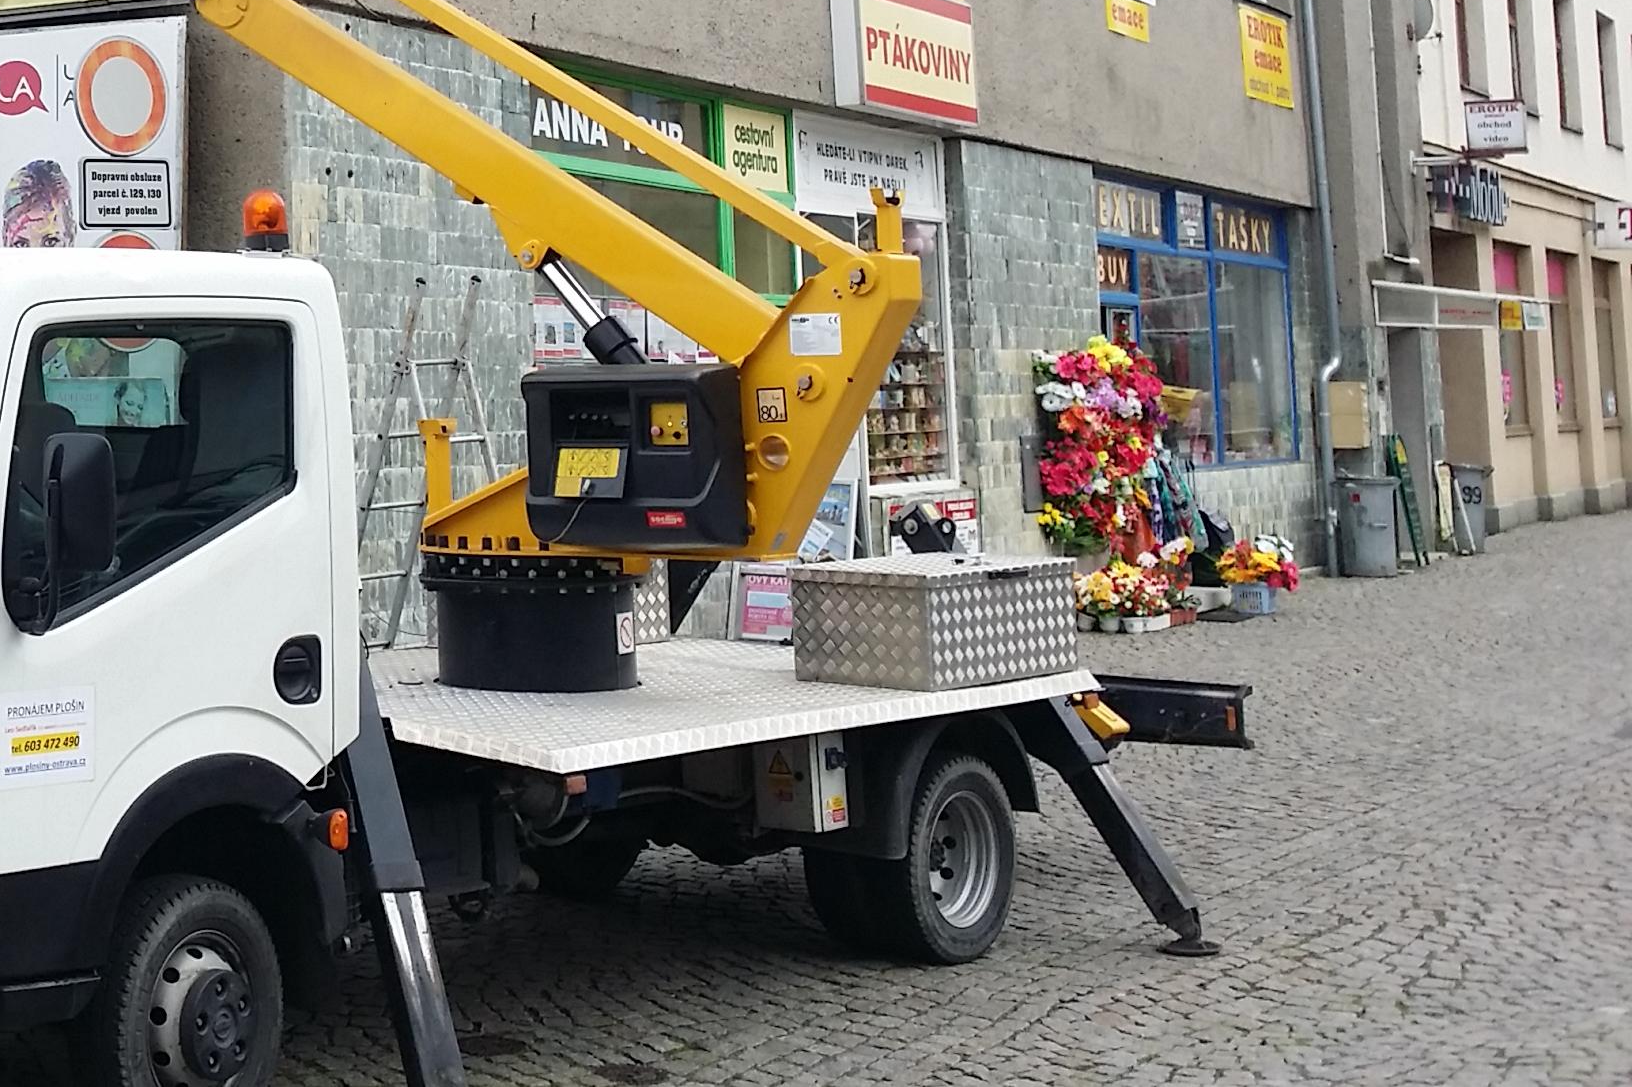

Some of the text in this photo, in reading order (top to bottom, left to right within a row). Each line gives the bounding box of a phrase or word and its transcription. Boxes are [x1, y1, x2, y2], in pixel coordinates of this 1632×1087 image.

[1111, 3, 1144, 30] emace
[1246, 14, 1285, 50] EROTIK
[866, 23, 972, 85] PTÁKOVINY
[1254, 49, 1283, 74] emace
[1469, 103, 1520, 114] EROTIK
[532, 97, 609, 148] ANNA
[1477, 120, 1512, 129] obchod
[734, 122, 775, 148] cestovní
[1483, 134, 1509, 143] video
[816, 141, 855, 162] HLEDÁTE-LI
[732, 149, 778, 177] agentura
[130, 171, 162, 183] obsluze
[850, 173, 866, 187] JSTE
[869, 175, 879, 188] HO
[92, 188, 119, 201] parcel
[97, 205, 158, 216] vjezd povolen
[1098, 185, 1160, 236] EXTIL
[1217, 207, 1270, 254] TAŠKY
[1098, 253, 1128, 285] BUV
[7, 698, 85, 718] PRONÁJEM PLOŠIN
[24, 740, 41, 752] 603
[44, 738, 61, 750] 472
[63, 735, 80, 747] 490
